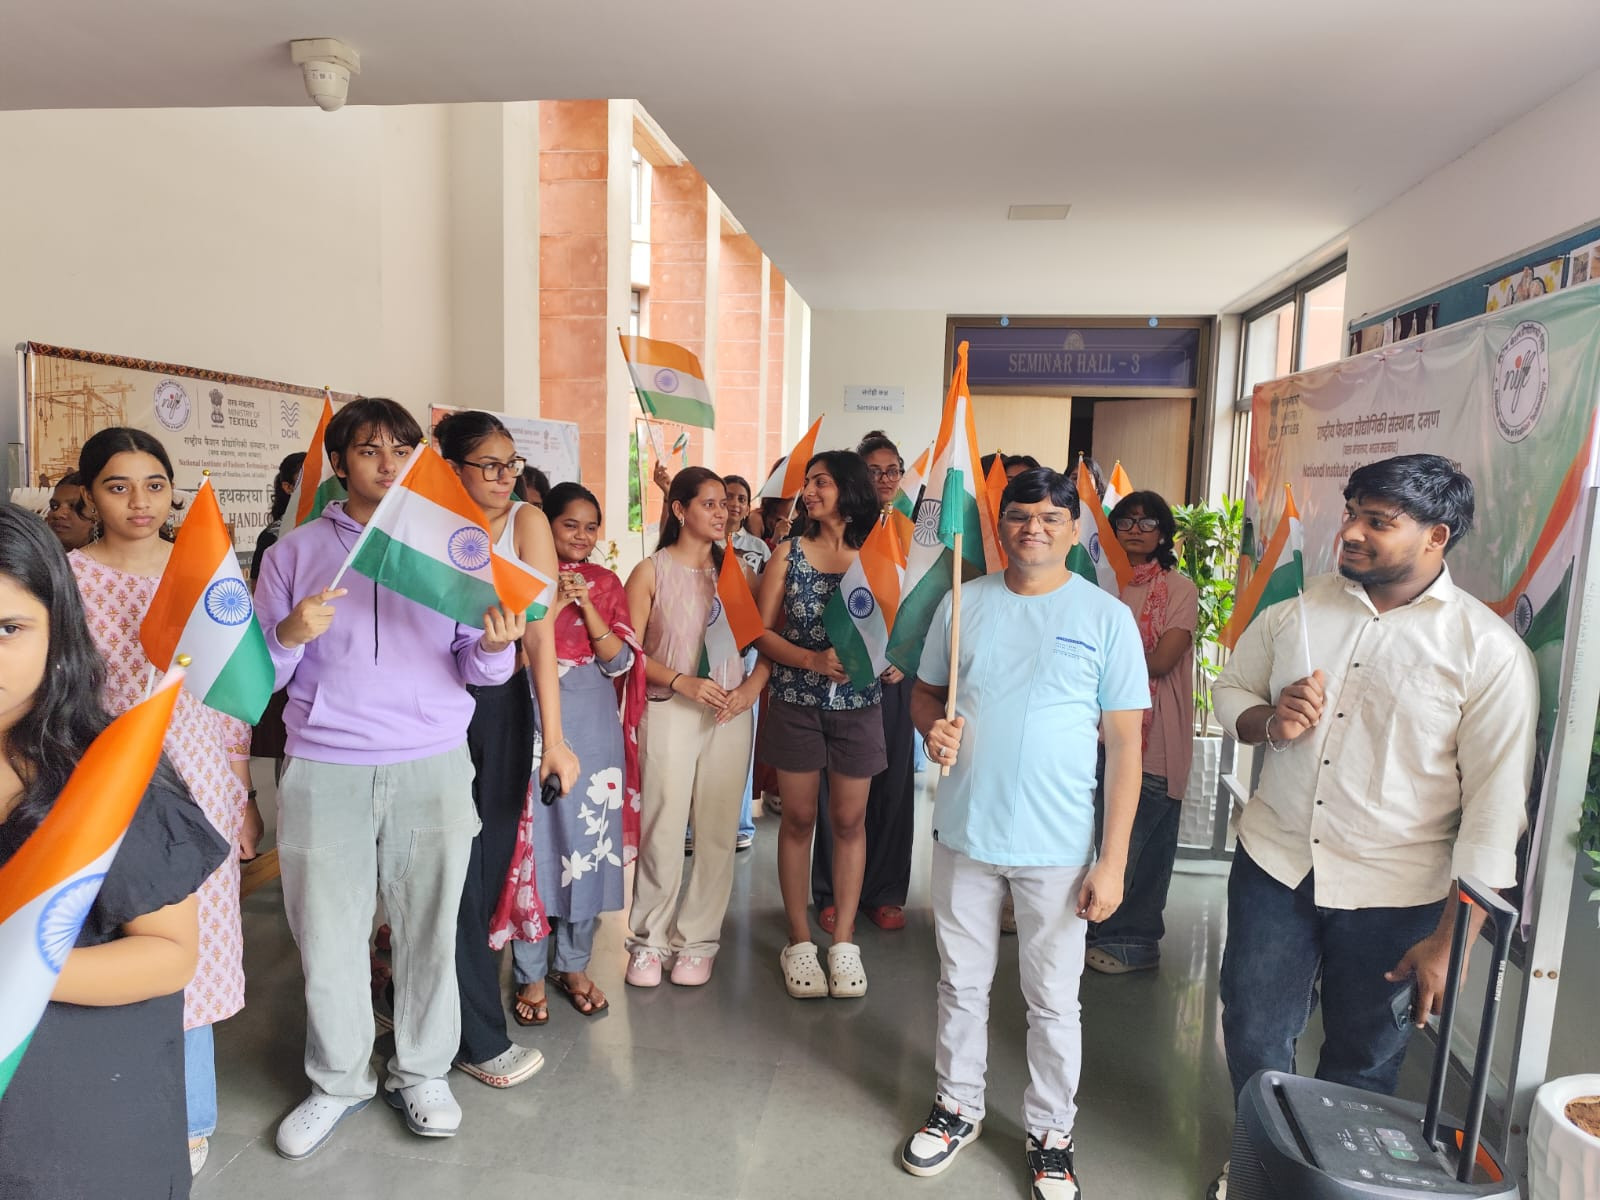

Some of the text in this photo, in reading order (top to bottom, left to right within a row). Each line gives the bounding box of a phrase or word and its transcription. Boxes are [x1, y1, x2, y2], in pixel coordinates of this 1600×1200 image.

[1008, 352, 1073, 374] SEMINAR
[1077, 352, 1115, 374] HALL
[1131, 353, 1140, 374] 3
[228, 408, 252, 416] MINISTRY
[228, 417, 258, 428] TEXTILES
[1417, 410, 1440, 431] दमण
[281, 429, 300, 440] DCHL
[1303, 463, 1325, 478] National
[218, 488, 263, 506] हथकरघा
[480, 1073, 509, 1085] crocs
